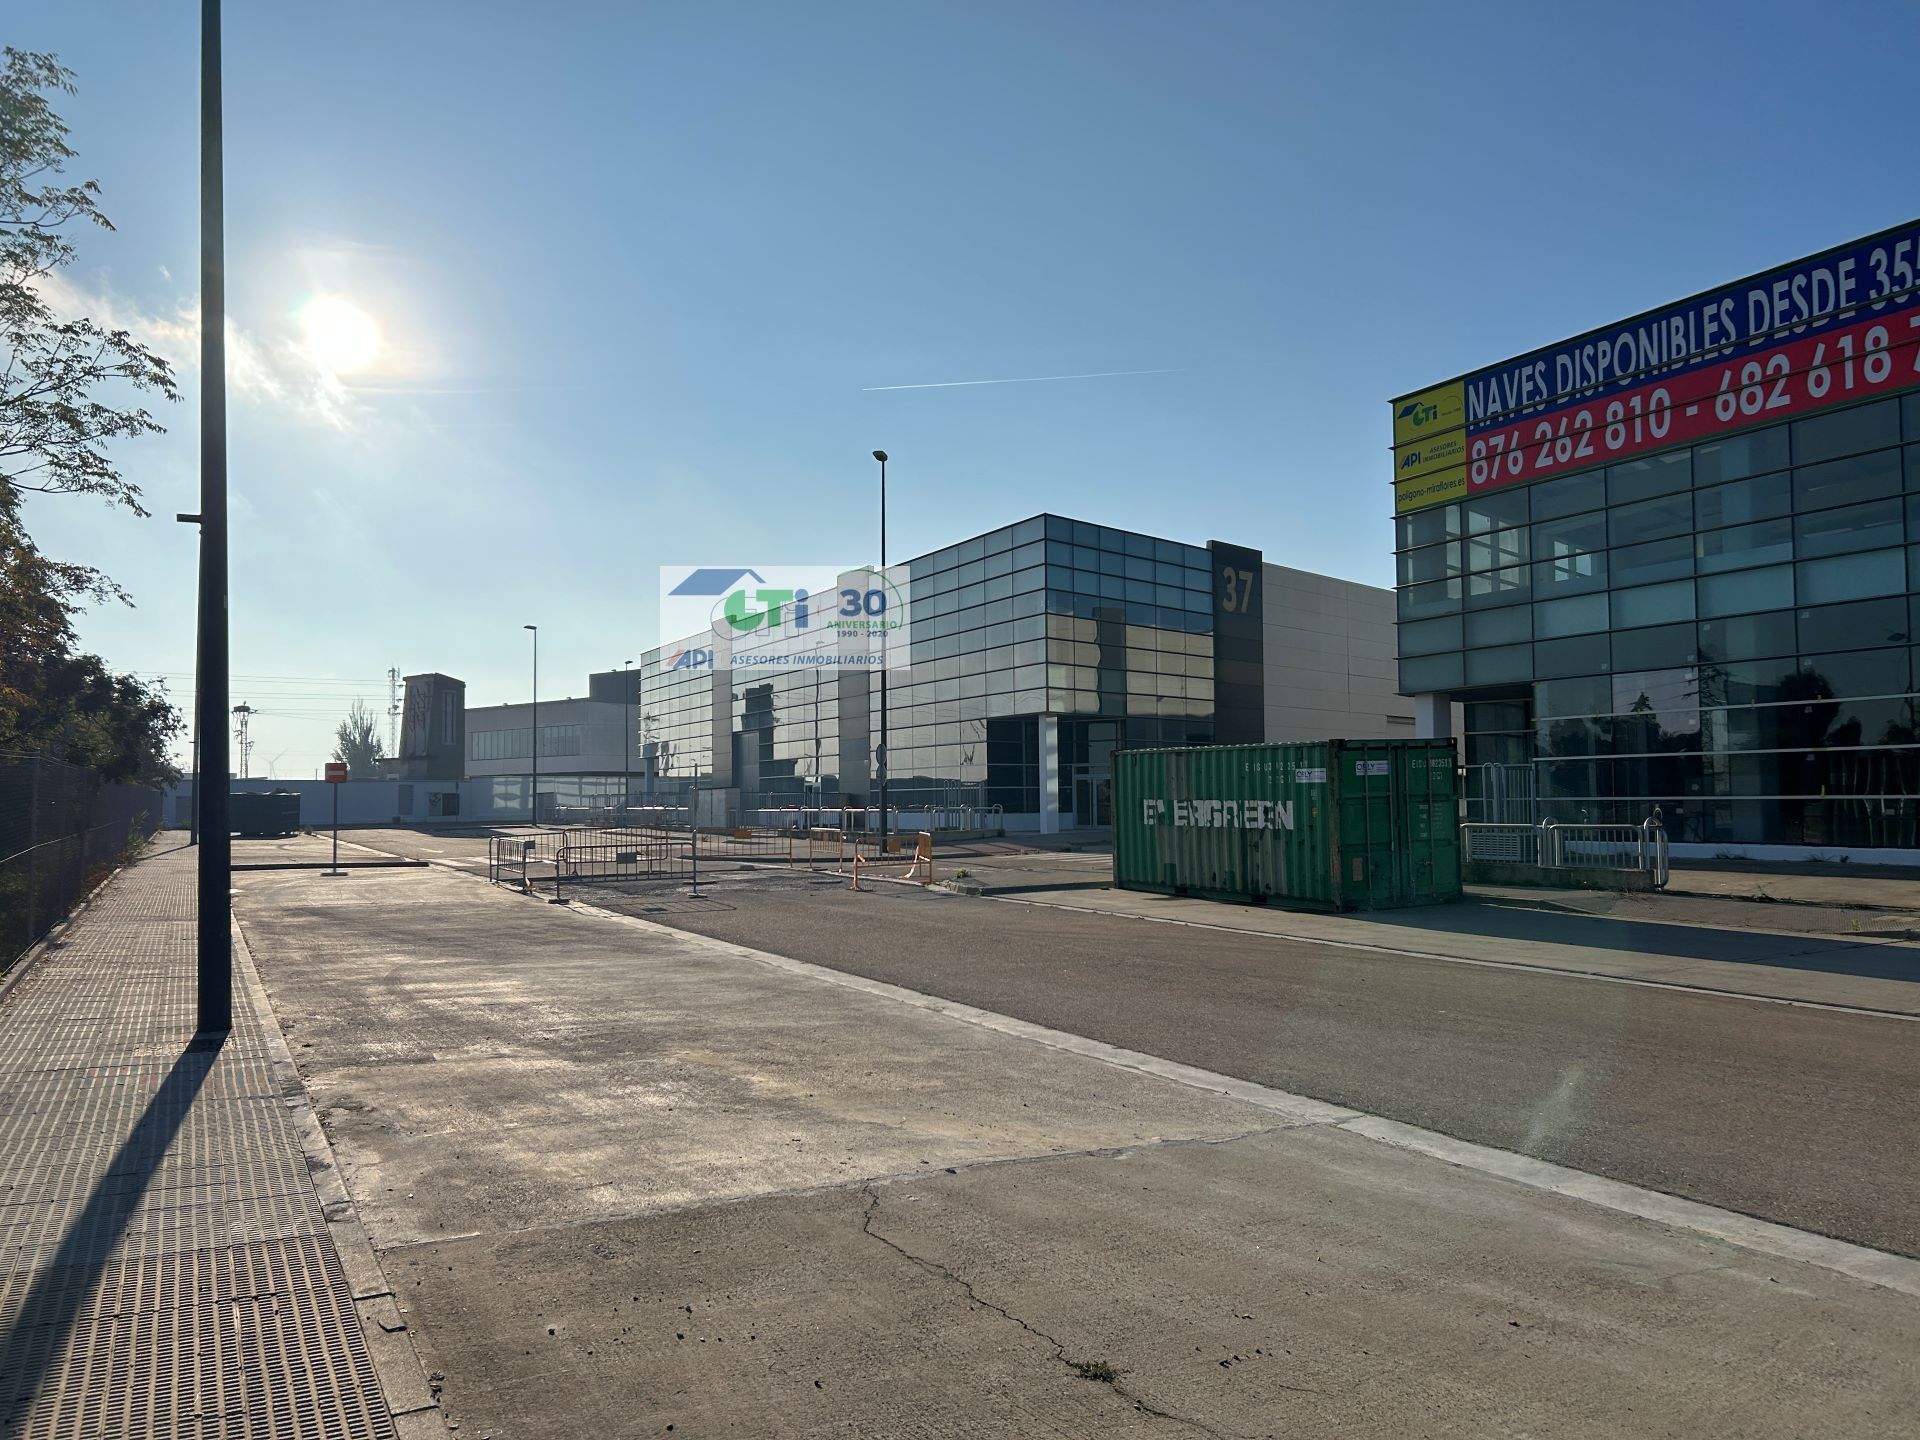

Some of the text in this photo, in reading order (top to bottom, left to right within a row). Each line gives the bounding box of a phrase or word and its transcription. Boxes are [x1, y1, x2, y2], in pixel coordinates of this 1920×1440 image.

[1468, 360, 1547, 430] NAVES
[1556, 297, 1737, 405] DISPONIBLES
[1748, 257, 1857, 347] DESDE
[1868, 235, 1920, 311] 35
[1471, 430, 1524, 485] 876
[1534, 409, 1593, 469] 262
[1605, 387, 1671, 450] 810
[1714, 353, 1791, 422] 682
[1807, 325, 1892, 399] 618
[1401, 451, 1421, 469] API
[1422, 445, 1465, 463] INMOBILIARIOS
[1430, 440, 1457, 453] ASESORES
[1222, 566, 1254, 613] 37
